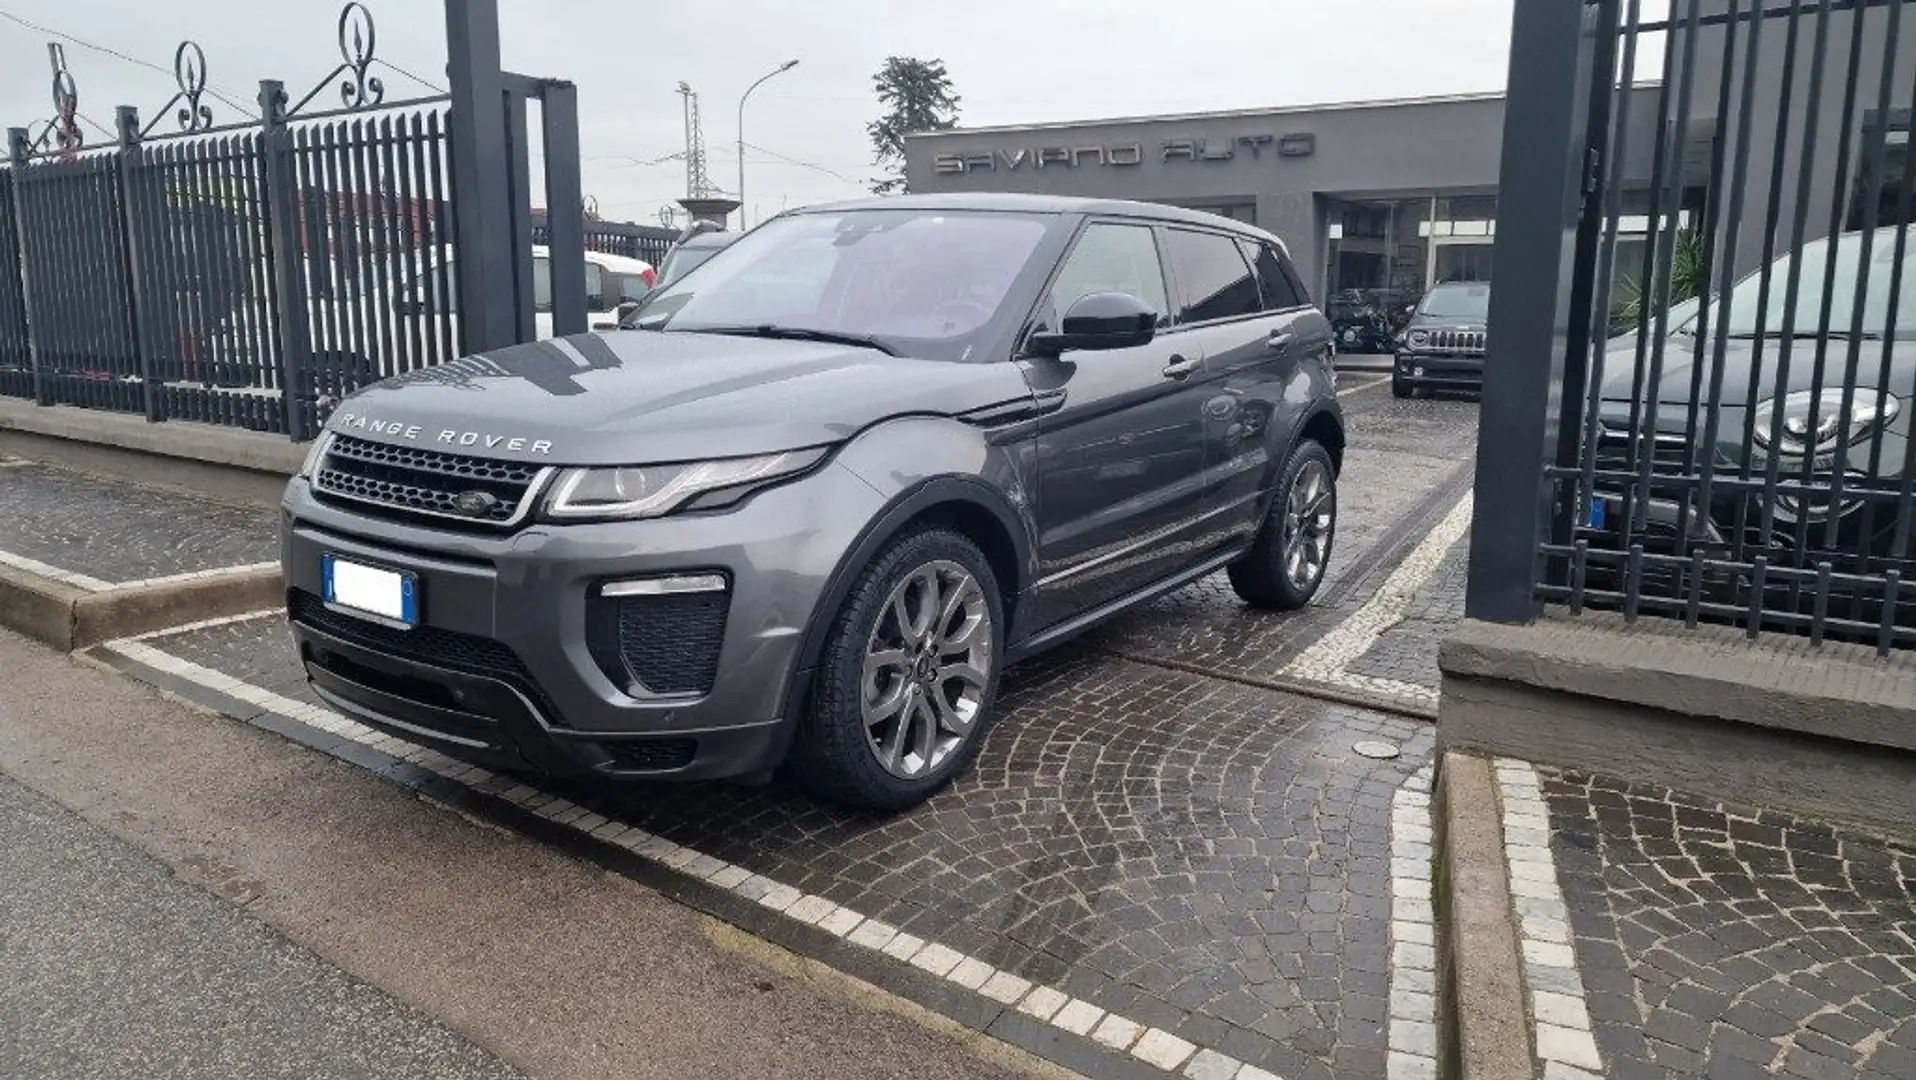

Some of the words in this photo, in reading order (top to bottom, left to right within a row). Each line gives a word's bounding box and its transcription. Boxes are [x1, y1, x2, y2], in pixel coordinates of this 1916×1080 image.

[934, 142, 1143, 174] SAVIANO
[1161, 133, 1316, 163] AUTO
[341, 412, 423, 440] RANGE
[437, 429, 553, 455] ROVER
